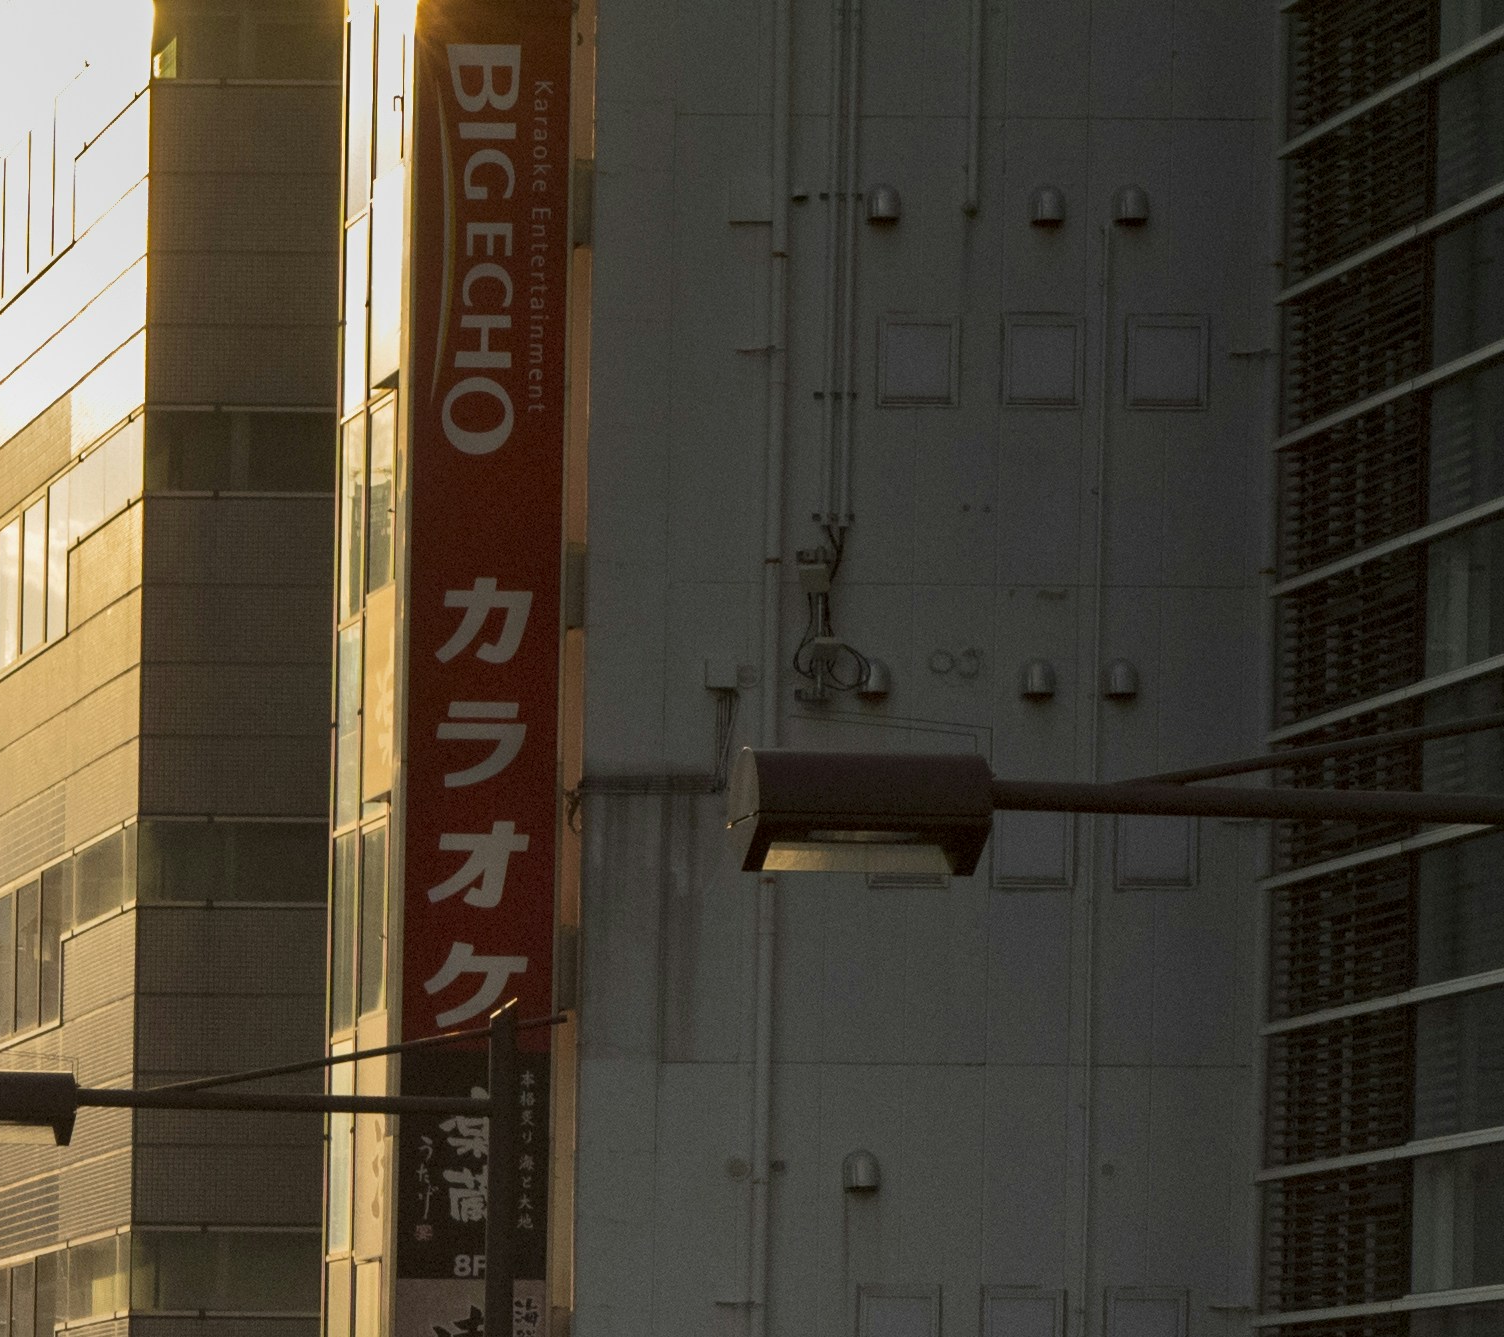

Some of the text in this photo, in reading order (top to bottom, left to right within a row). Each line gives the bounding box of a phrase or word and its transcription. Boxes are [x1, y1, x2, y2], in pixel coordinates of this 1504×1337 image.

[526, 81, 554, 413] Karaoke Entertainment
[423, 577, 533, 1028] カラオケ
